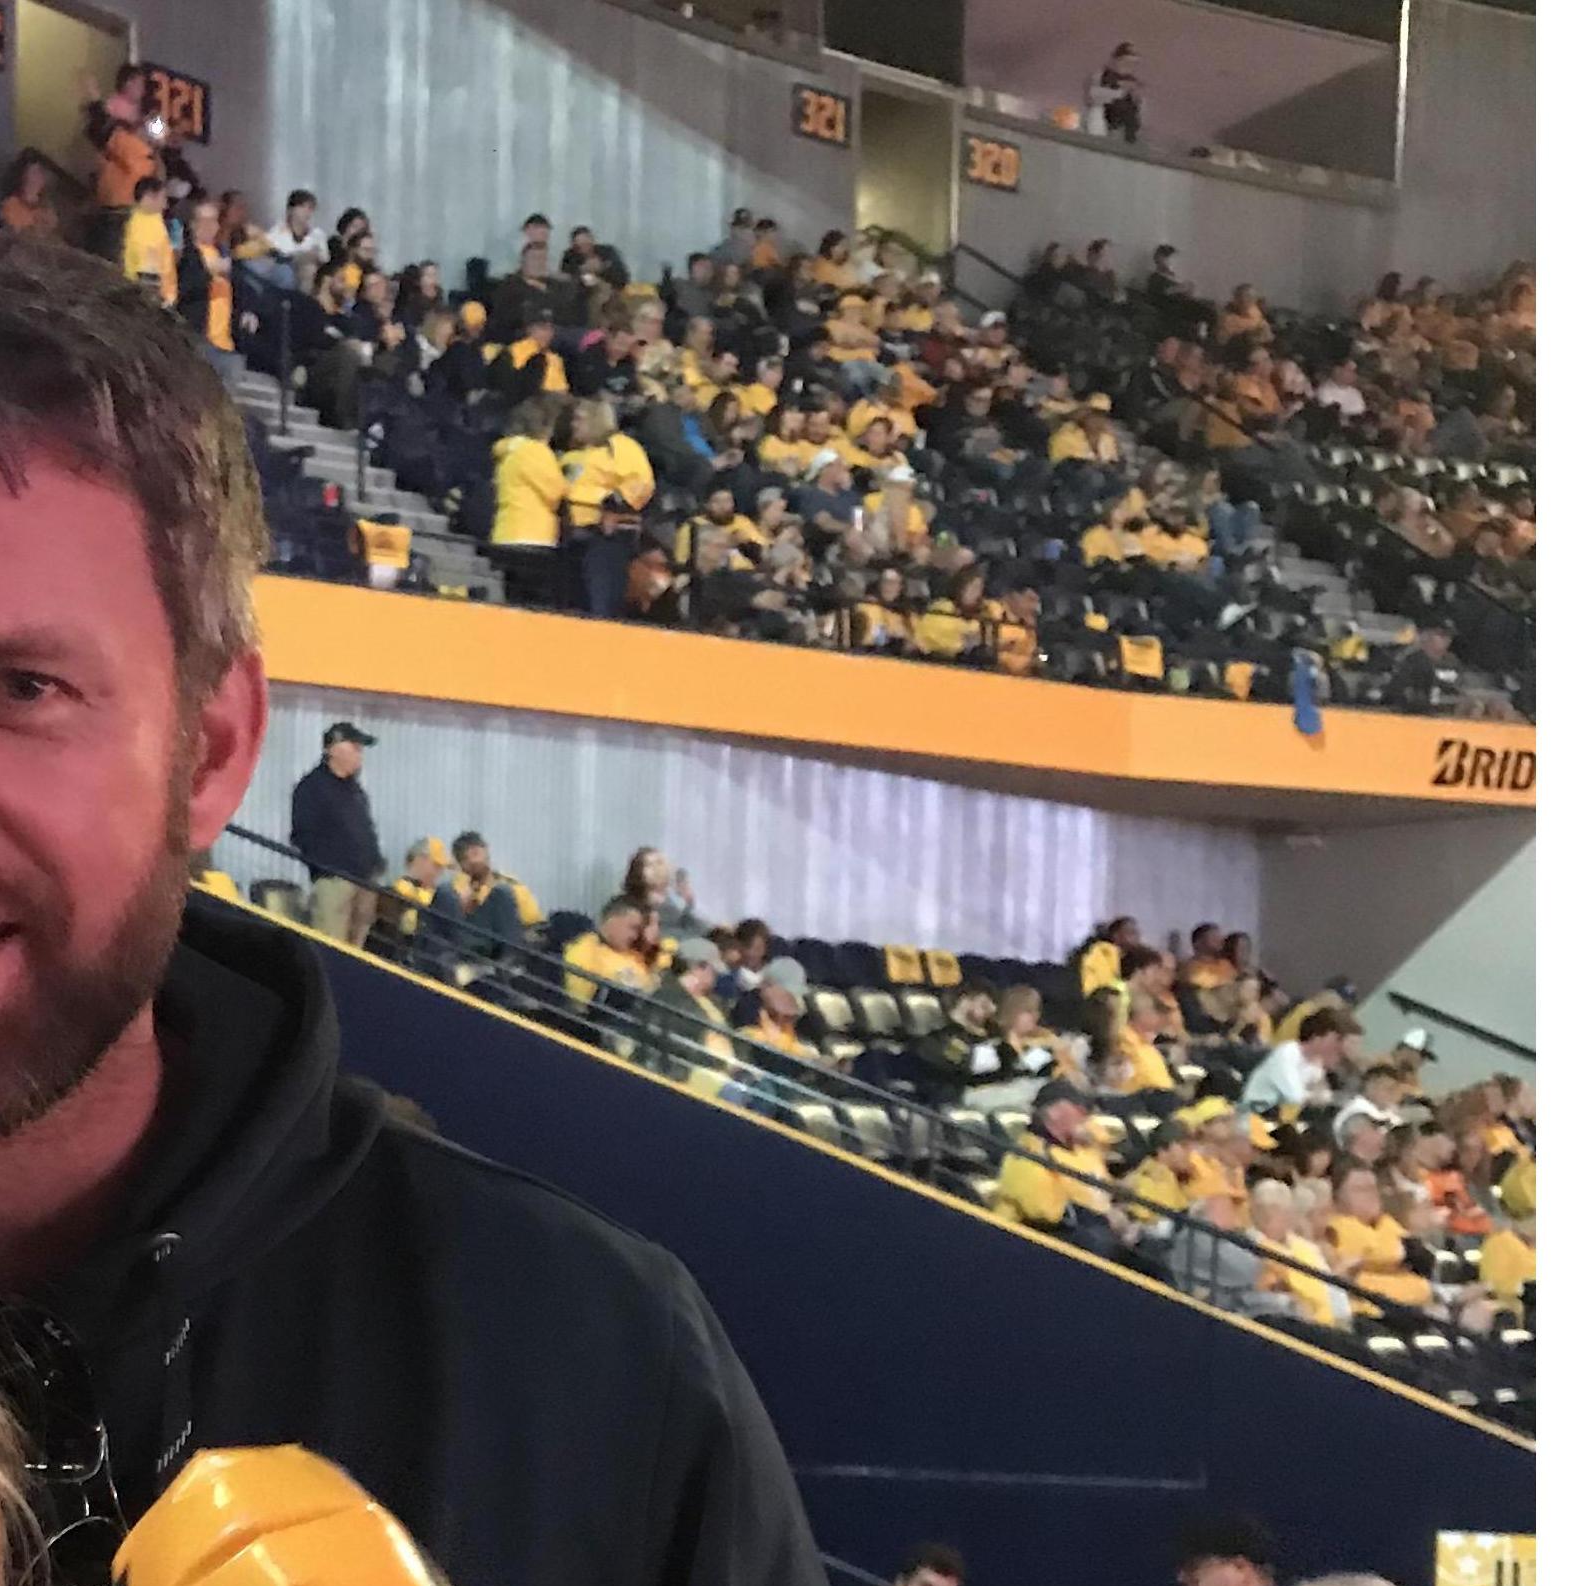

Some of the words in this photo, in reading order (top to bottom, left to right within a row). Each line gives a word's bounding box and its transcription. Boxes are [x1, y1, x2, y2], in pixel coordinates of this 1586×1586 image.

[800, 89, 847, 143] 321
[967, 136, 1021, 187] 320
[1431, 738, 1536, 789] BRID
